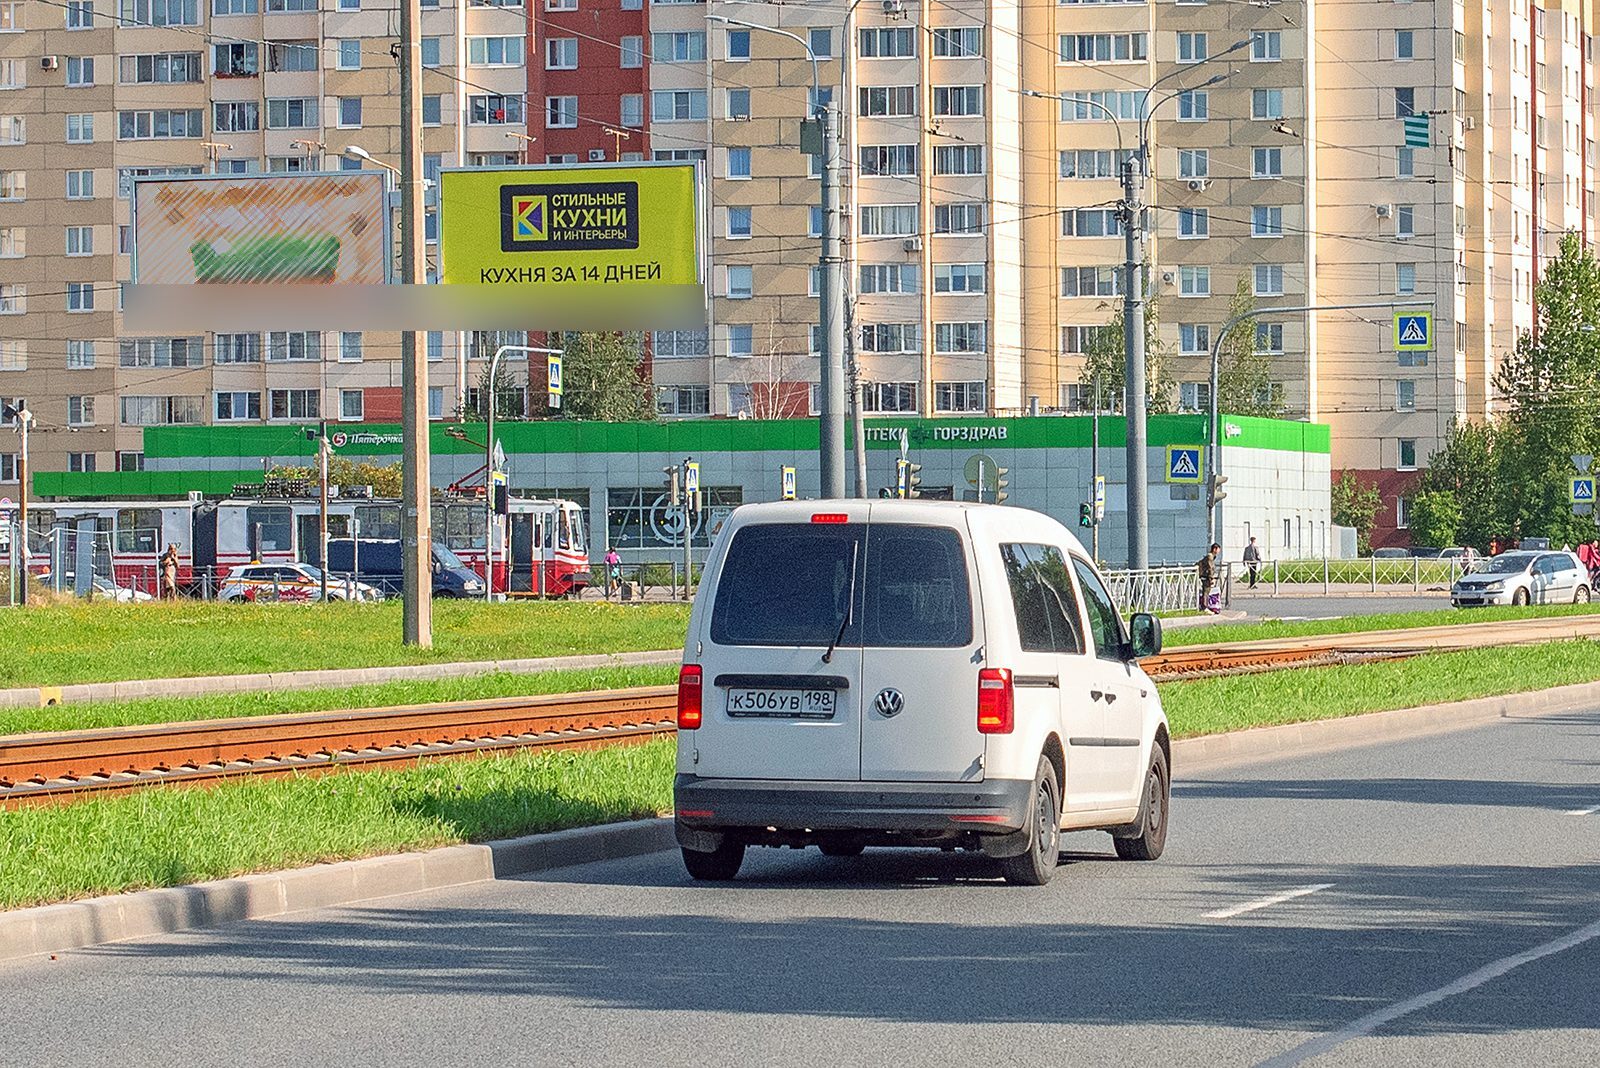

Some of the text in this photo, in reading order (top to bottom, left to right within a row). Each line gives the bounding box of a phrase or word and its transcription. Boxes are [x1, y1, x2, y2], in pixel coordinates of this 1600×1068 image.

[552, 193, 626, 207] СТИЛЬНЫЕ
[553, 208, 627, 228] КУХНИ
[553, 229, 627, 240] И ИНТЕРЬЕРЫ
[480, 261, 661, 283] КУХНЯ ЗА 14 ДНЕЙ
[864, 426, 1008, 442] ПТЕКИ ГОРЗДРАВ
[733, 691, 828, 710] К506УВ 198
